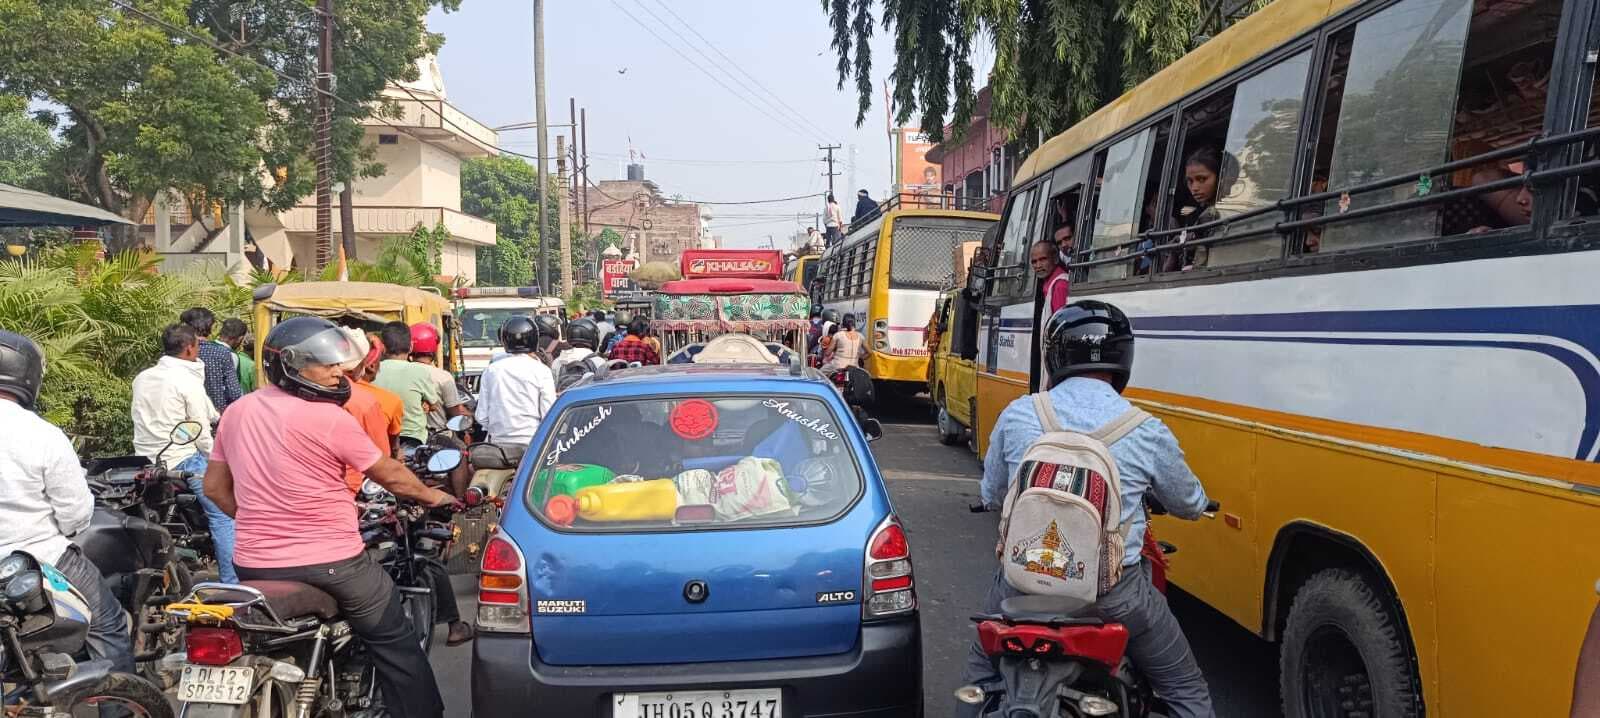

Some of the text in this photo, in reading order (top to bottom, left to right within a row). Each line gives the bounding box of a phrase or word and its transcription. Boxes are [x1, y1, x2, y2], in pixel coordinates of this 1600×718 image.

[706, 261, 753, 272] KHALSA
[762, 399, 838, 440] Anushka
[547, 406, 612, 466] Ankush
[818, 591, 855, 602] ALTO
[199, 669, 237, 685] DL 12
[722, 699, 777, 718] 3747
